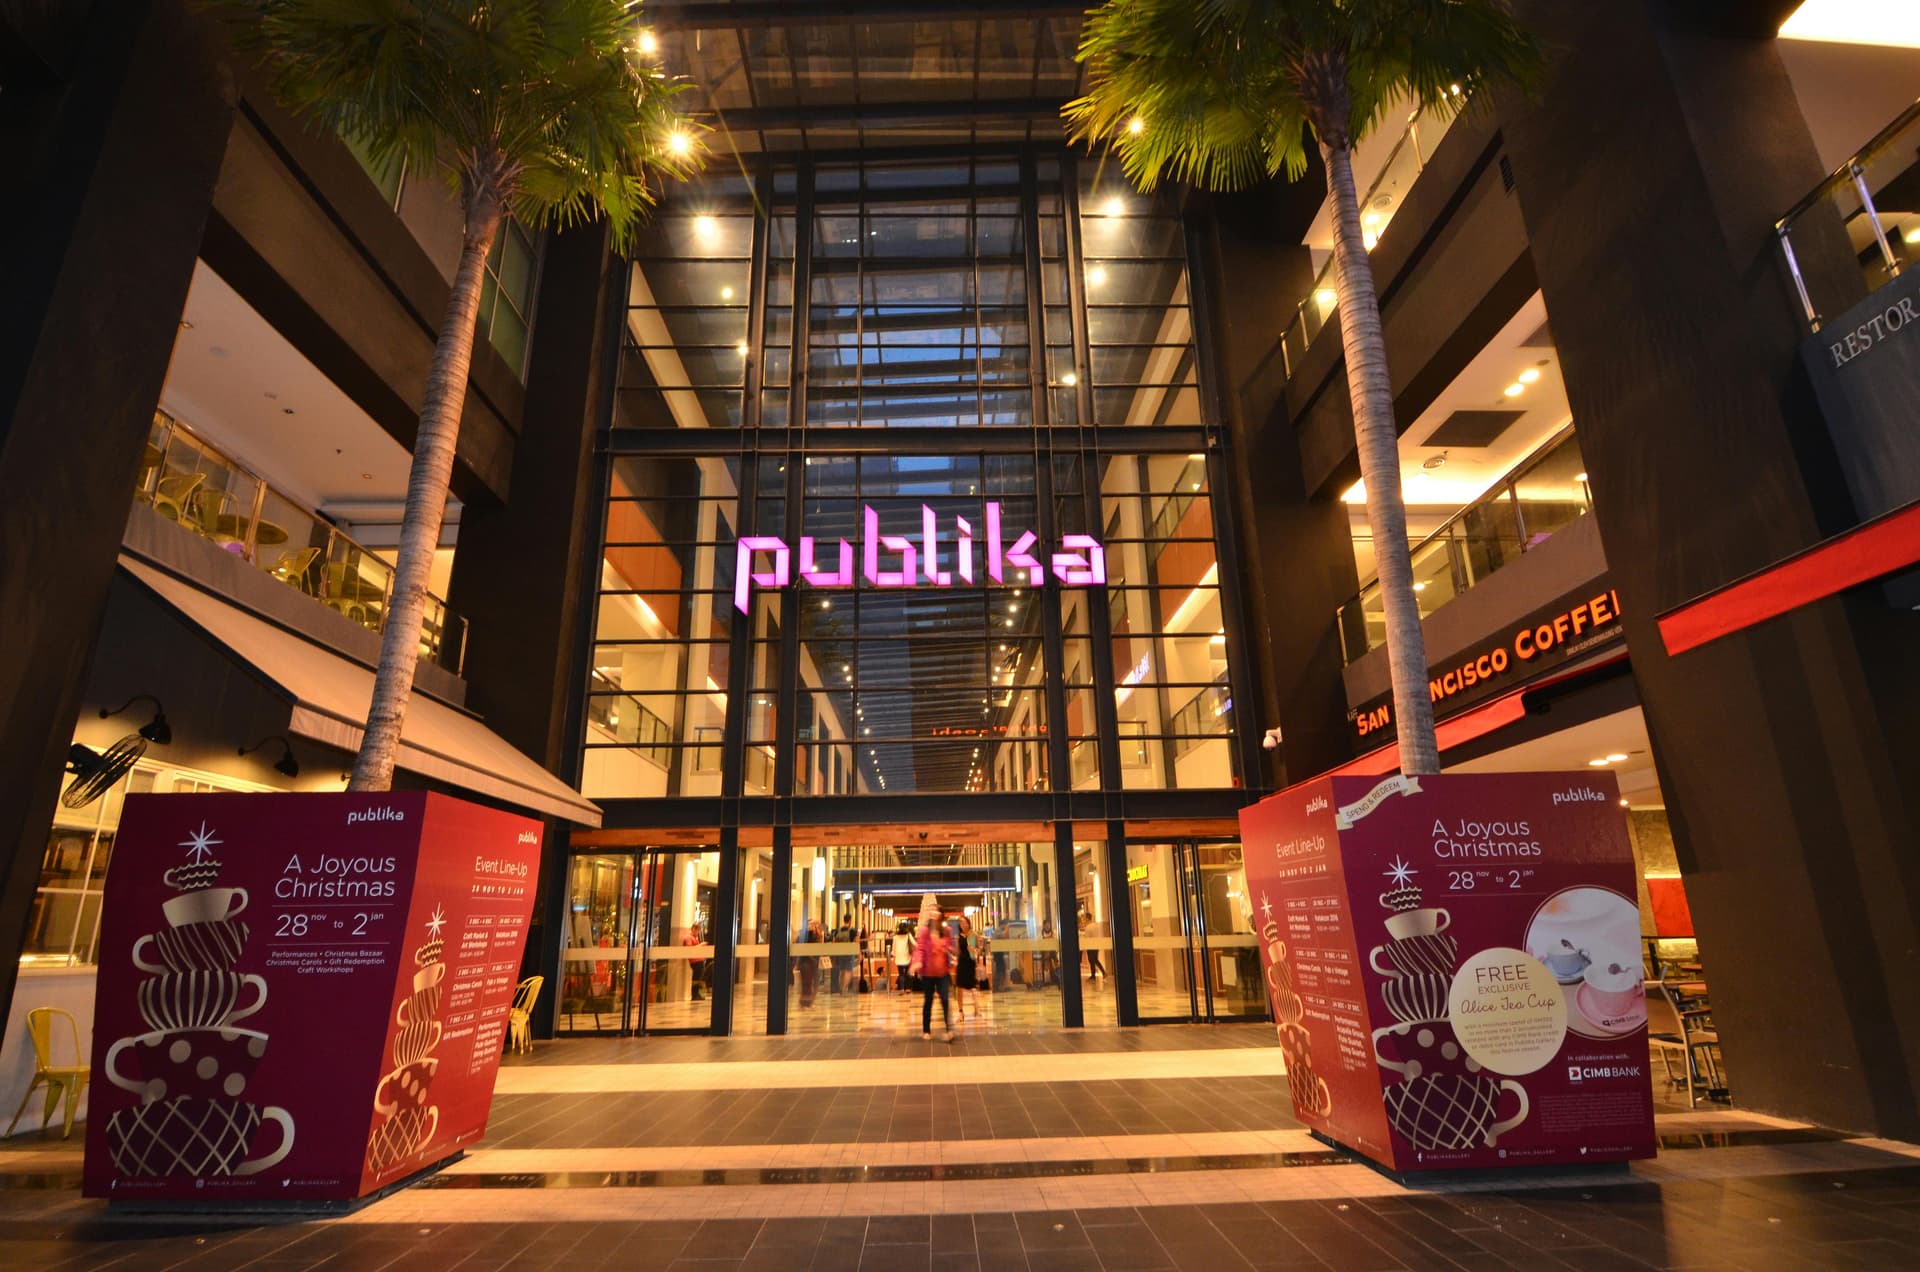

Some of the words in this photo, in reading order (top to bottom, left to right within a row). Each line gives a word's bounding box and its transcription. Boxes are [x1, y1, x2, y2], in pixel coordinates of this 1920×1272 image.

[1829, 291, 1920, 368] RESTOR
[734, 502, 1105, 616] publika
[1356, 704, 1390, 736] SAN
[1428, 647, 1508, 703] NCISCO
[1305, 794, 1328, 816] publika
[1345, 801, 1370, 819] SPEND
[1367, 797, 1374, 806] &
[1371, 781, 1401, 800] REDEEM
[1552, 786, 1606, 805] publika
[347, 806, 405, 825] publika
[518, 831, 538, 845] publika
[1431, 819, 1449, 837] A
[1455, 818, 1530, 840] Joyous
[1275, 842, 1296, 859] Event
[1296, 834, 1325, 855] Line-Up
[1434, 839, 1542, 858] Christmas
[283, 853, 302, 874] A
[310, 853, 397, 877] Joyous
[475, 856, 498, 873] Event
[499, 859, 528, 878] Line-Up
[274, 876, 396, 899] Christmas
[1448, 871, 1475, 890] 28
[1476, 870, 1490, 878] nov
[1495, 875, 1504, 883] to
[1508, 870, 1521, 889] 2
[1522, 869, 1534, 877] jan
[274, 913, 309, 937] 28
[311, 912, 327, 921] nov
[333, 919, 344, 929] to
[351, 912, 369, 936] 2
[370, 911, 384, 921] jan
[265, 959, 300, 967] Christmas
[301, 958, 322, 966] Carols
[329, 958, 342, 966] Gift
[343, 958, 385, 966] Redemption
[271, 951, 318, 959] Performances
[324, 950, 358, 958] Christmas
[297, 966, 314, 974] Craft
[316, 966, 354, 974] Workshops
[1475, 964, 1529, 983] FREE
[1478, 982, 1531, 995] EXCLUSIVE
[1460, 998, 1498, 1015] Alice
[1501, 996, 1525, 1011] Tea
[1527, 993, 1556, 1012] Cup
[1583, 1067, 1611, 1079] CIMB
[1611, 1066, 1641, 1077] BANK
